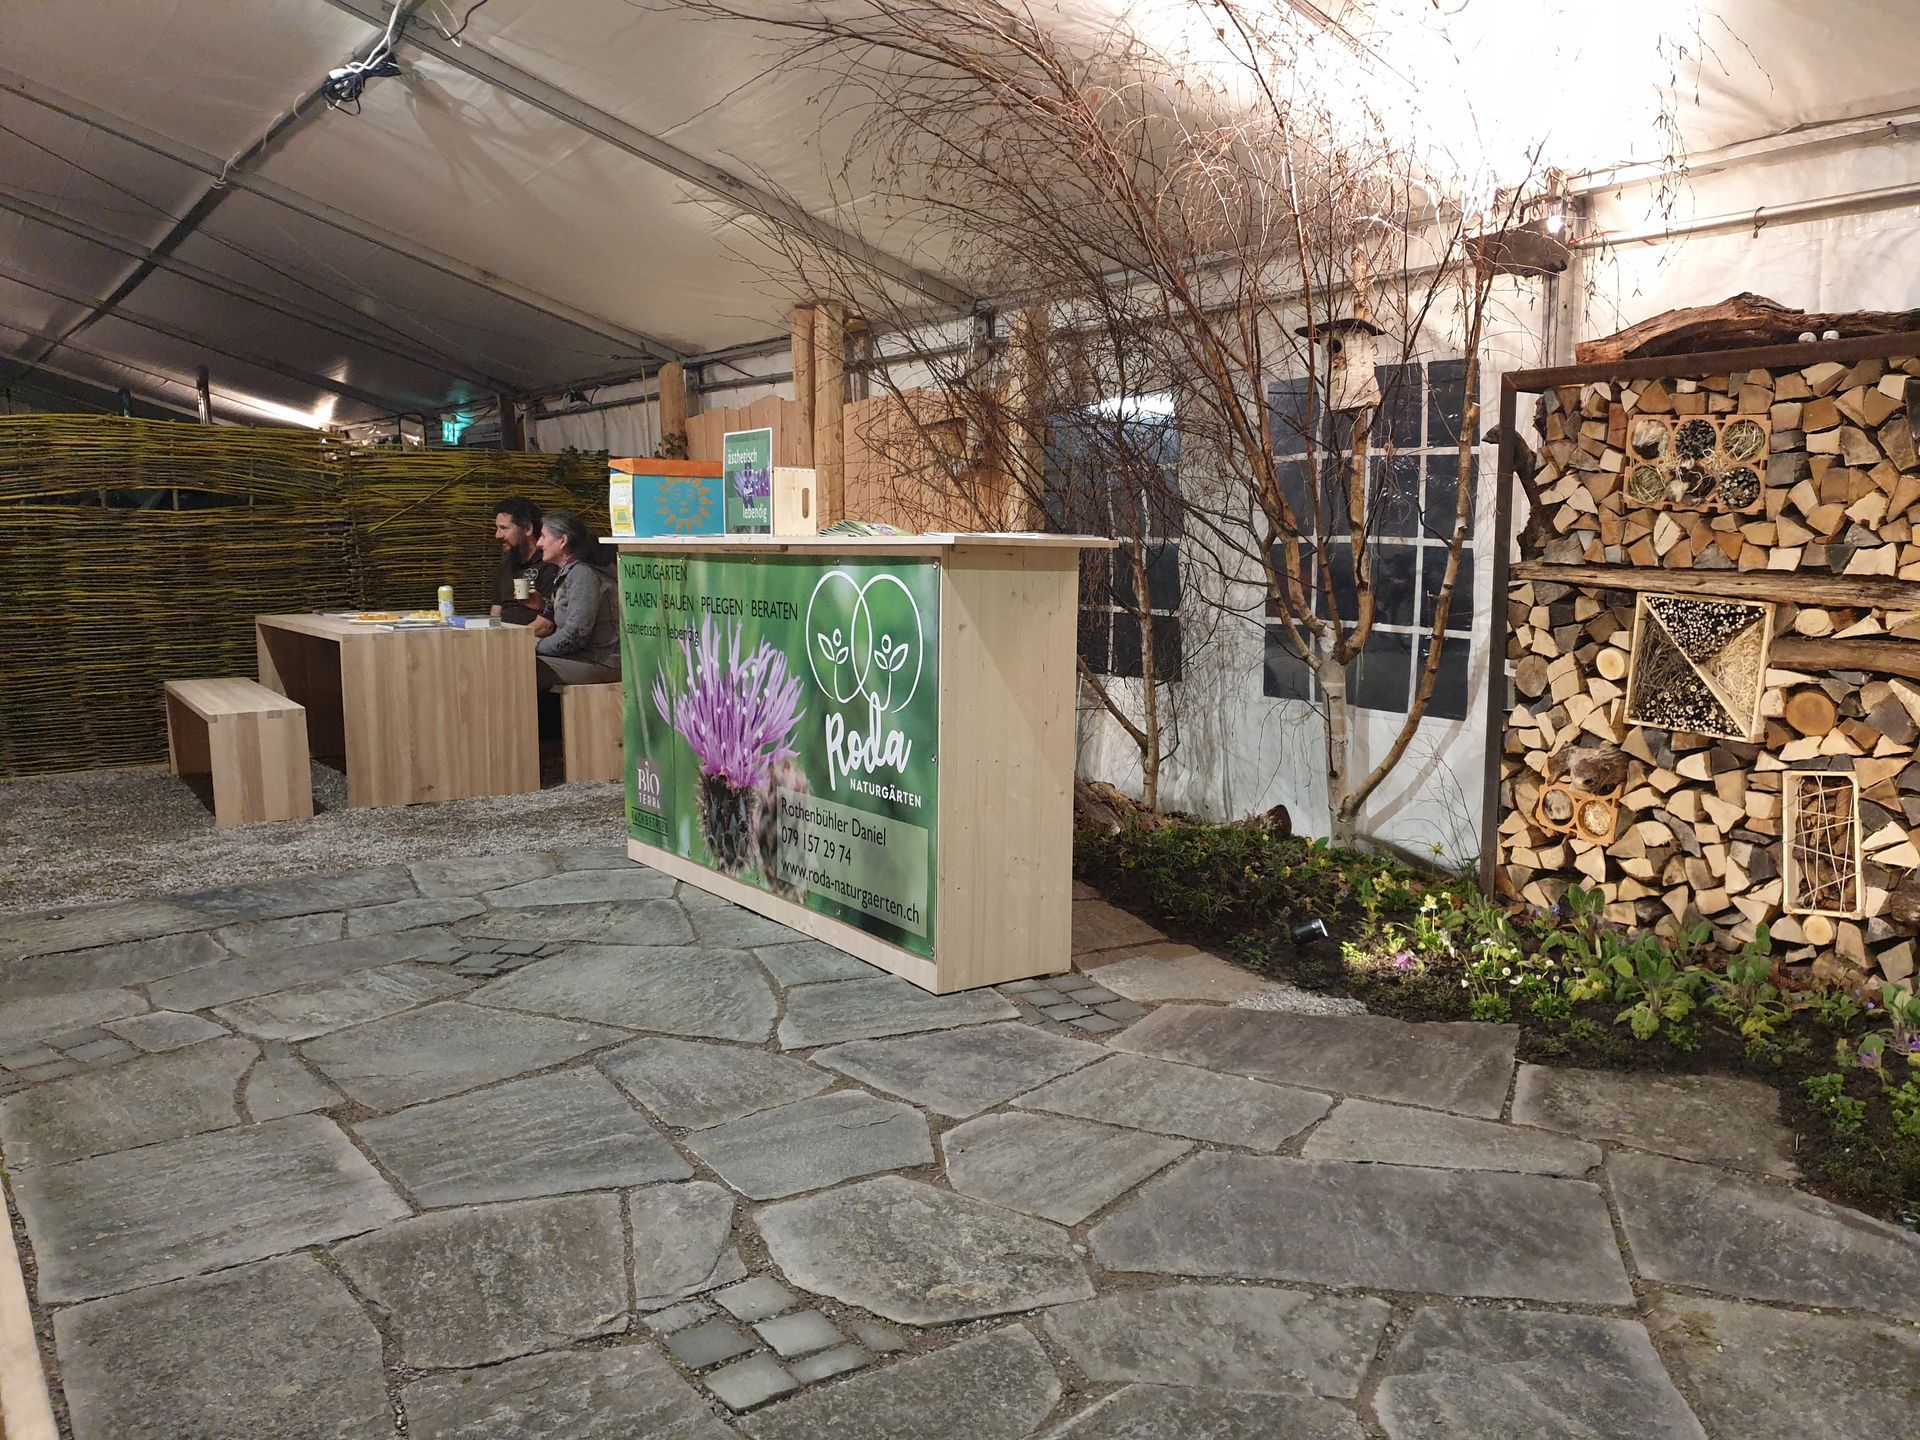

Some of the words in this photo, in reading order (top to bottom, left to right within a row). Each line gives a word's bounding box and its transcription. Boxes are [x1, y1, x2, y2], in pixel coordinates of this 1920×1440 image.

[742, 503, 768, 523] lebendig
[624, 563, 687, 581] NATURGARTEN
[625, 591, 658, 609] PLANEN
[664, 593, 694, 612] BAUEN
[701, 596, 743, 616] PFLEGEN
[751, 600, 798, 621] BERATEN
[626, 621, 661, 638] ästhetisch
[667, 623, 700, 647] lebendig
[825, 691, 912, 791] Roda
[637, 761, 660, 796] BIO
[850, 778, 922, 808] NATURGÄRTEN
[638, 792, 661, 809] TERRA
[781, 797, 849, 833] Rothenbühler
[851, 818, 887, 847] Daniel
[781, 826, 799, 847] 079
[803, 833, 820, 854] 157
[823, 839, 836, 860] 29
[839, 844, 852, 867] 74
[781, 859, 920, 925] www.roda-naturgaerten.ch
